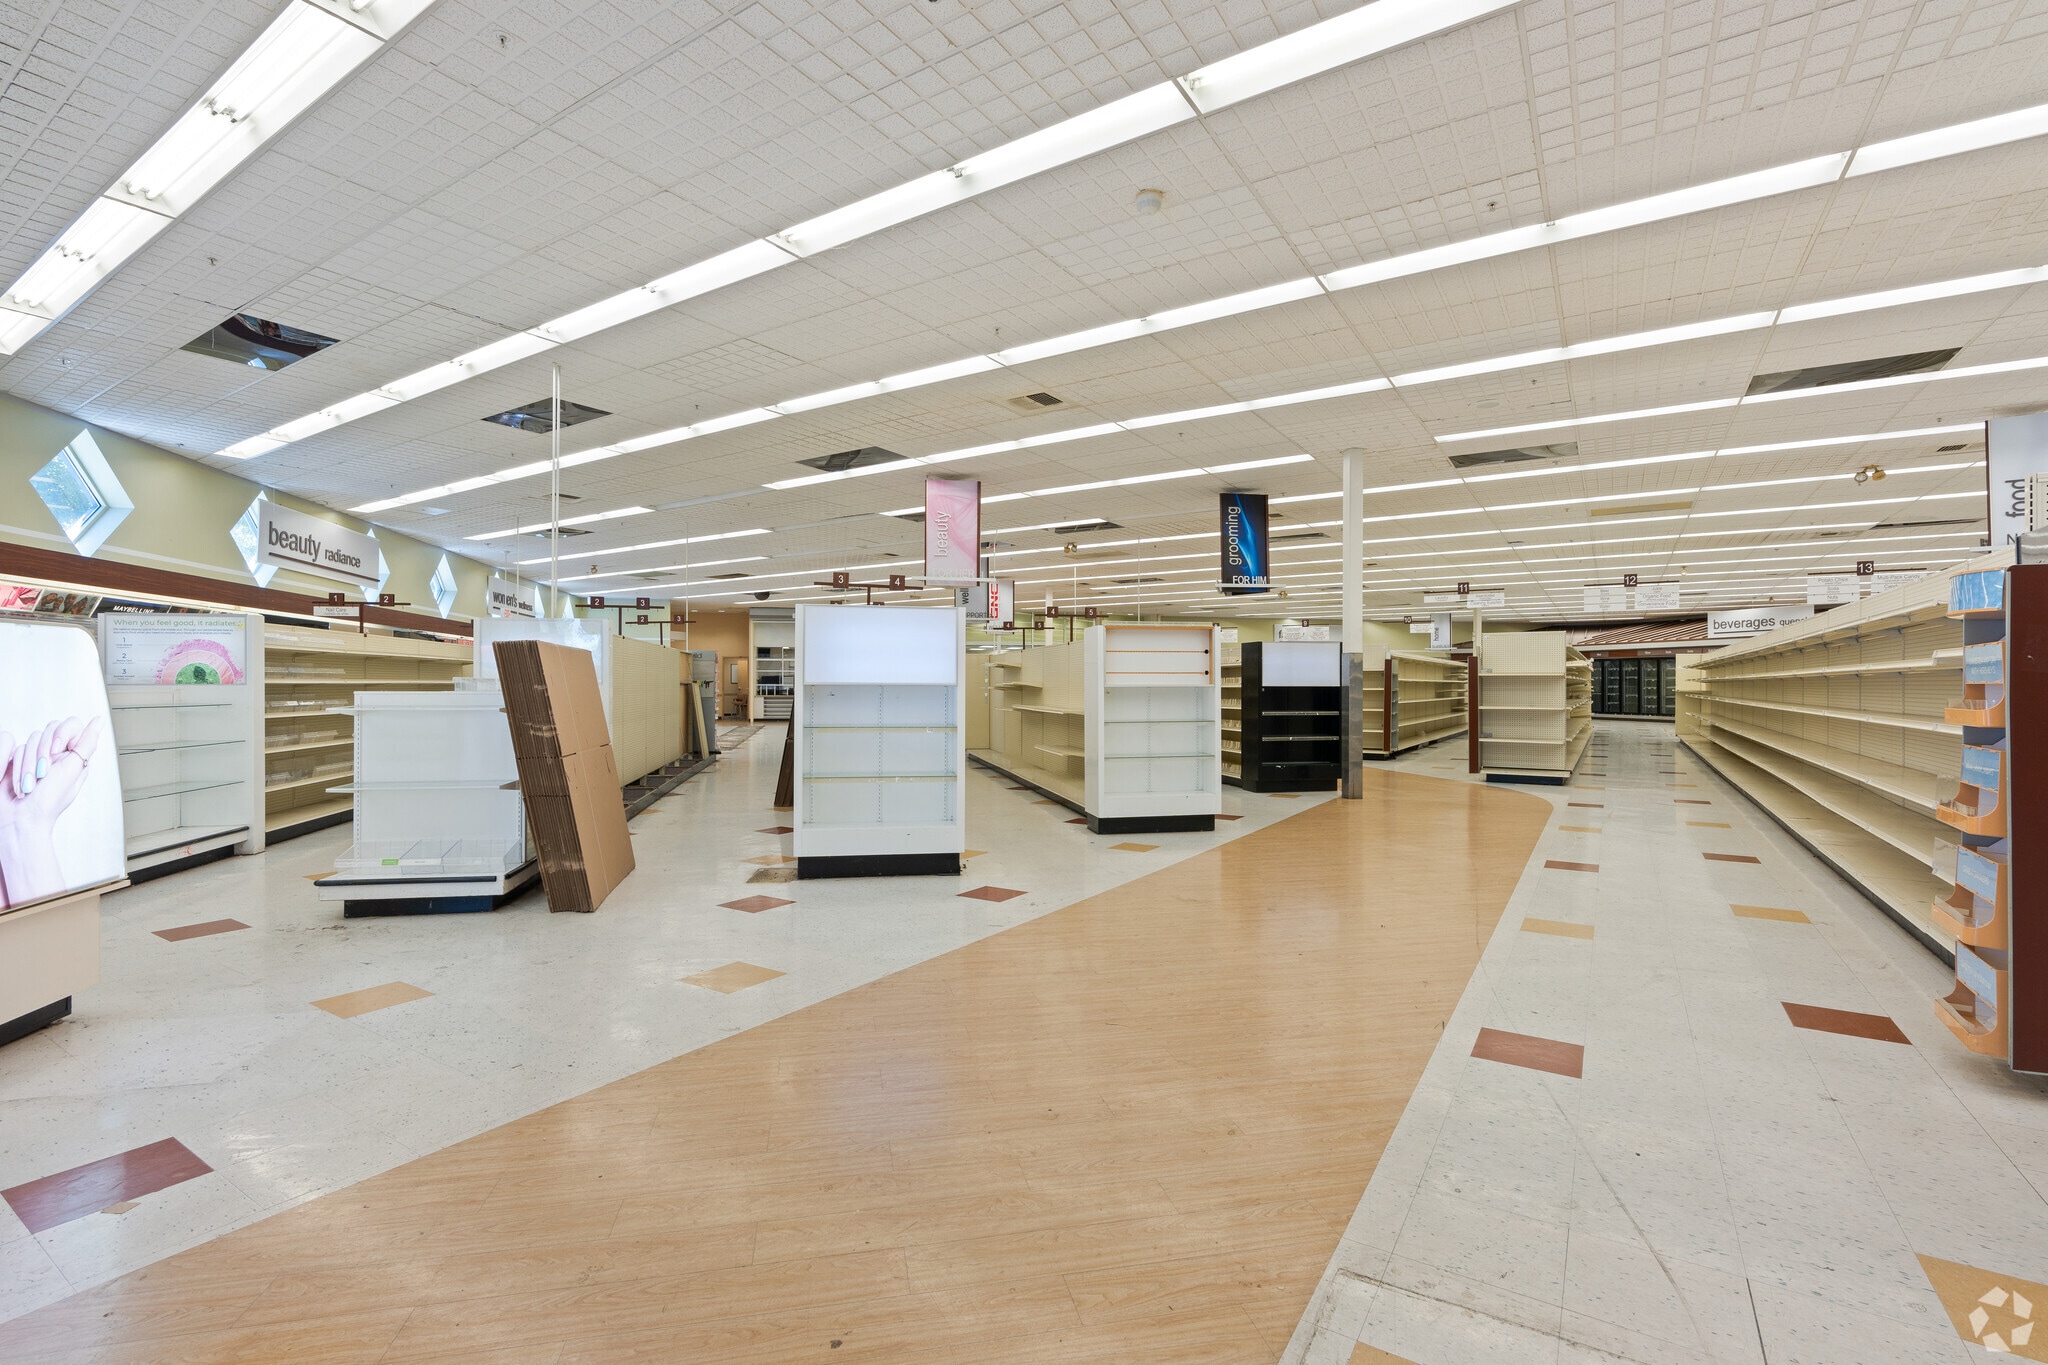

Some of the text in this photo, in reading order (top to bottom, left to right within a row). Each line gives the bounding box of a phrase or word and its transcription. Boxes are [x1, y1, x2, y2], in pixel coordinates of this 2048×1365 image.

[2005, 478, 2025, 518] food
[934, 510, 951, 557] beauty
[1226, 506, 1242, 566] grooming
[268, 520, 361, 568] beauty radiance
[1858, 563, 1873, 573] 13
[838, 575, 844, 584] 3
[894, 577, 900, 586] 4
[1232, 575, 1267, 585] FOR HIM
[1625, 576, 1636, 585] 12
[1459, 584, 1468, 593] 11
[990, 583, 999, 618] GNC
[113, 605, 155, 613] MAYBELLINE
[140, 620, 155, 628] you
[174, 619, 195, 628] good,
[205, 619, 236, 627] radiates
[1713, 617, 1808, 630] beverages quen
